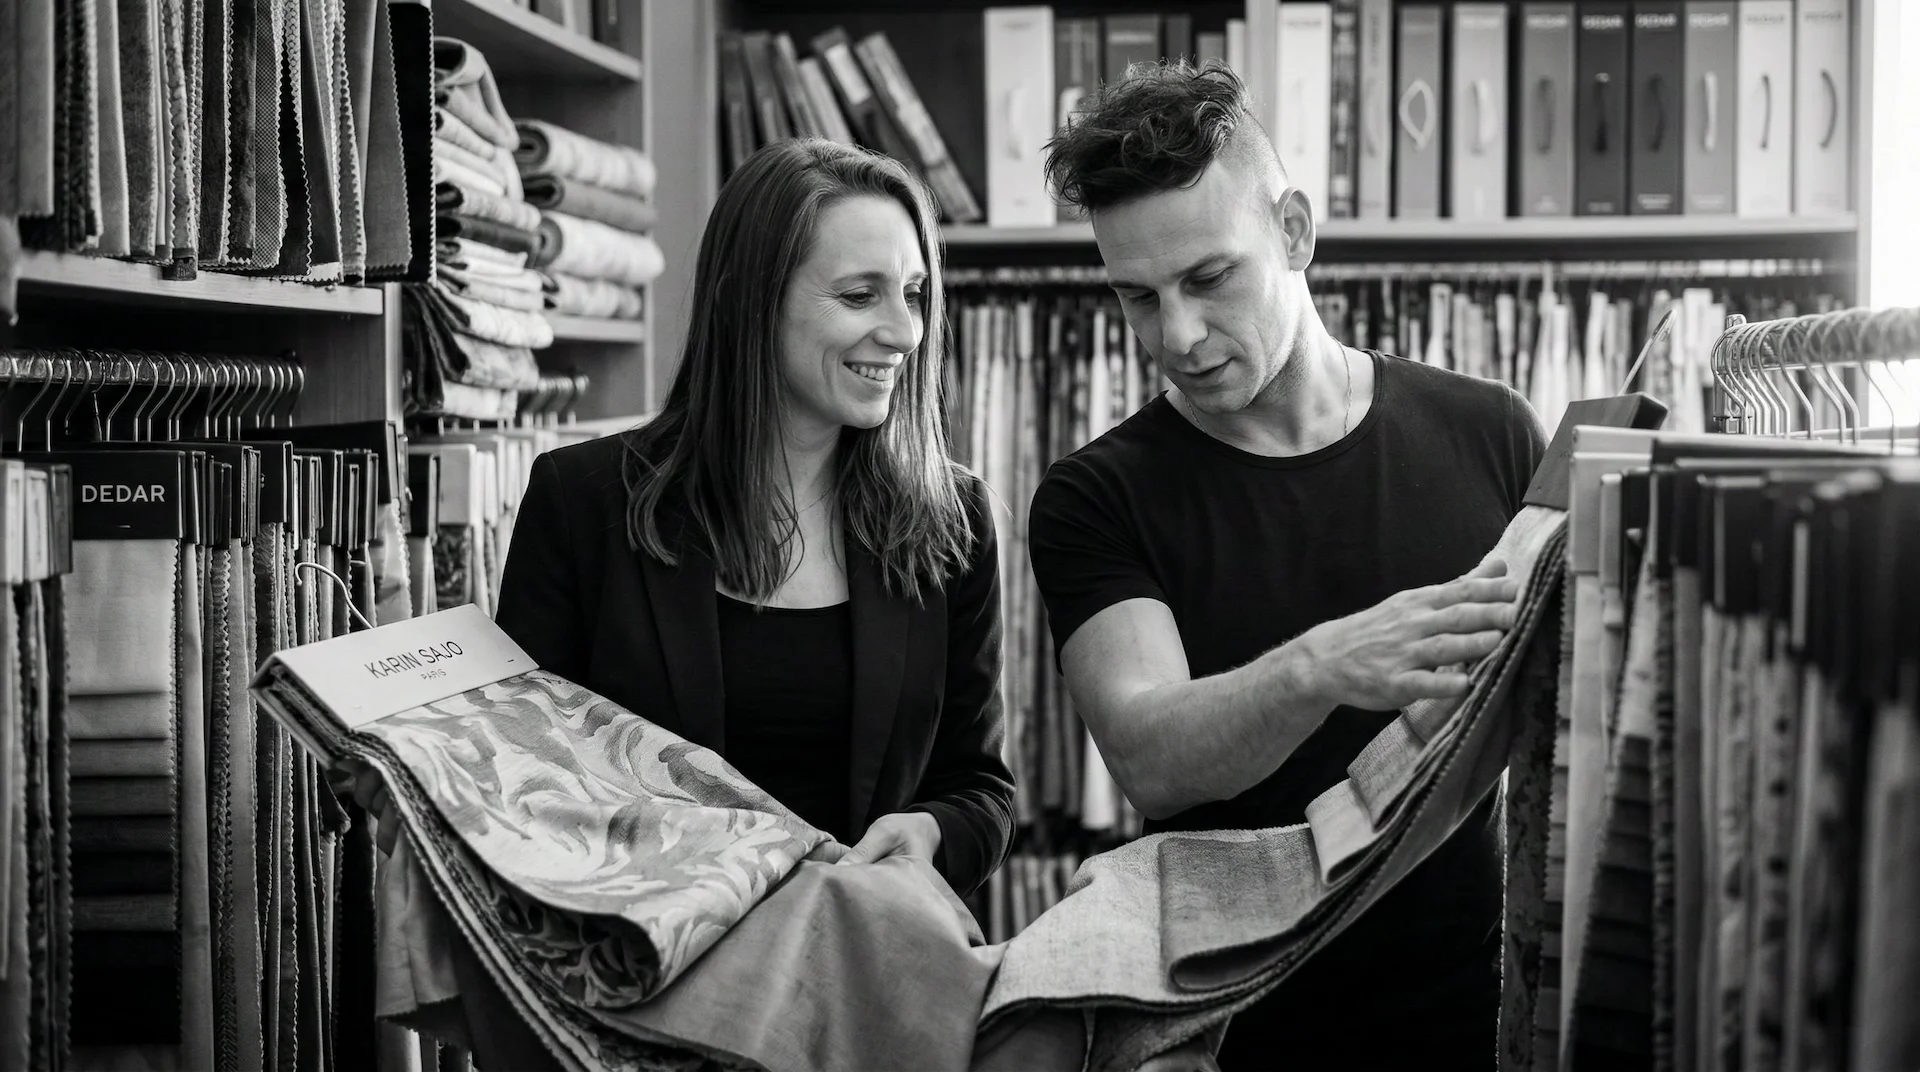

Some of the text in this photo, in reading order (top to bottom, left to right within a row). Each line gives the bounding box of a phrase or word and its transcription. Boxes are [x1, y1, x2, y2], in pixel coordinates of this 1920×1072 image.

[82, 484, 165, 503] DEDAR
[364, 641, 463, 679] KARIN SAJO
